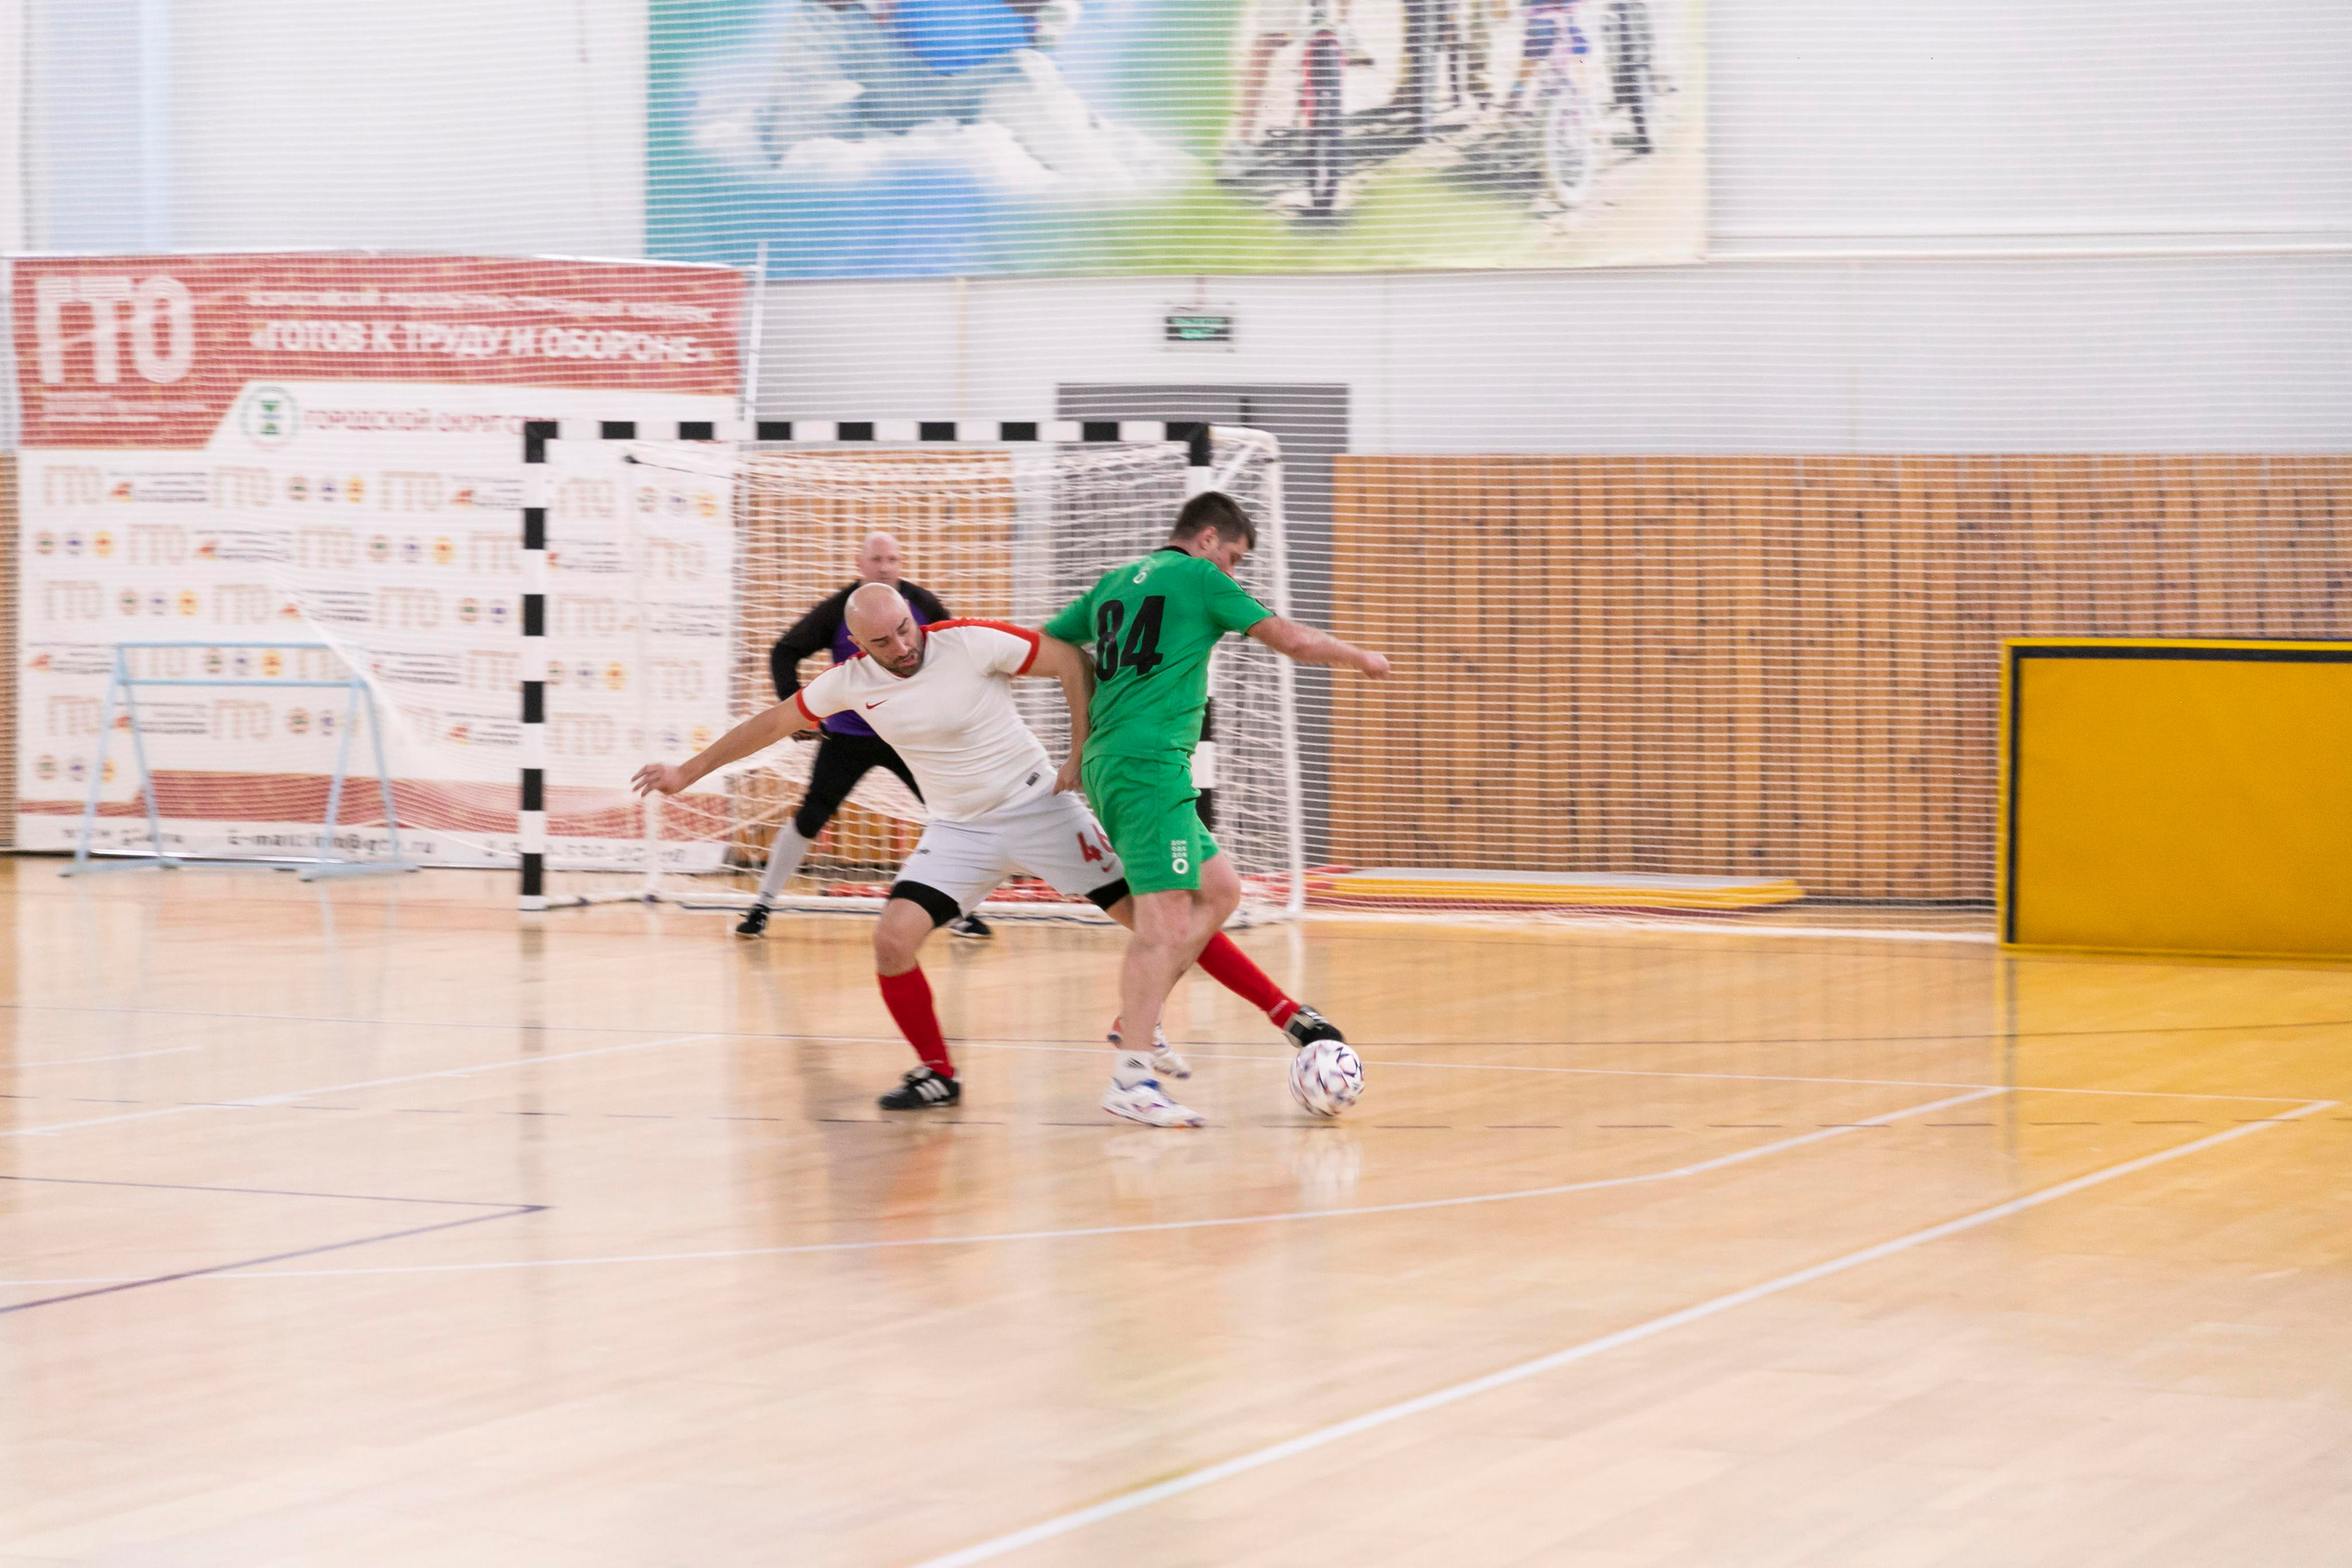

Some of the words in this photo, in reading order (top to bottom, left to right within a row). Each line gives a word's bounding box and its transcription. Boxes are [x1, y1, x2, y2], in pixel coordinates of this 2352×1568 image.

[36, 276, 192, 384] ГТО
[371, 321, 398, 352] К
[404, 322, 502, 359] ТРУДУ
[509, 326, 539, 357] И
[1095, 595, 1166, 682] 84
